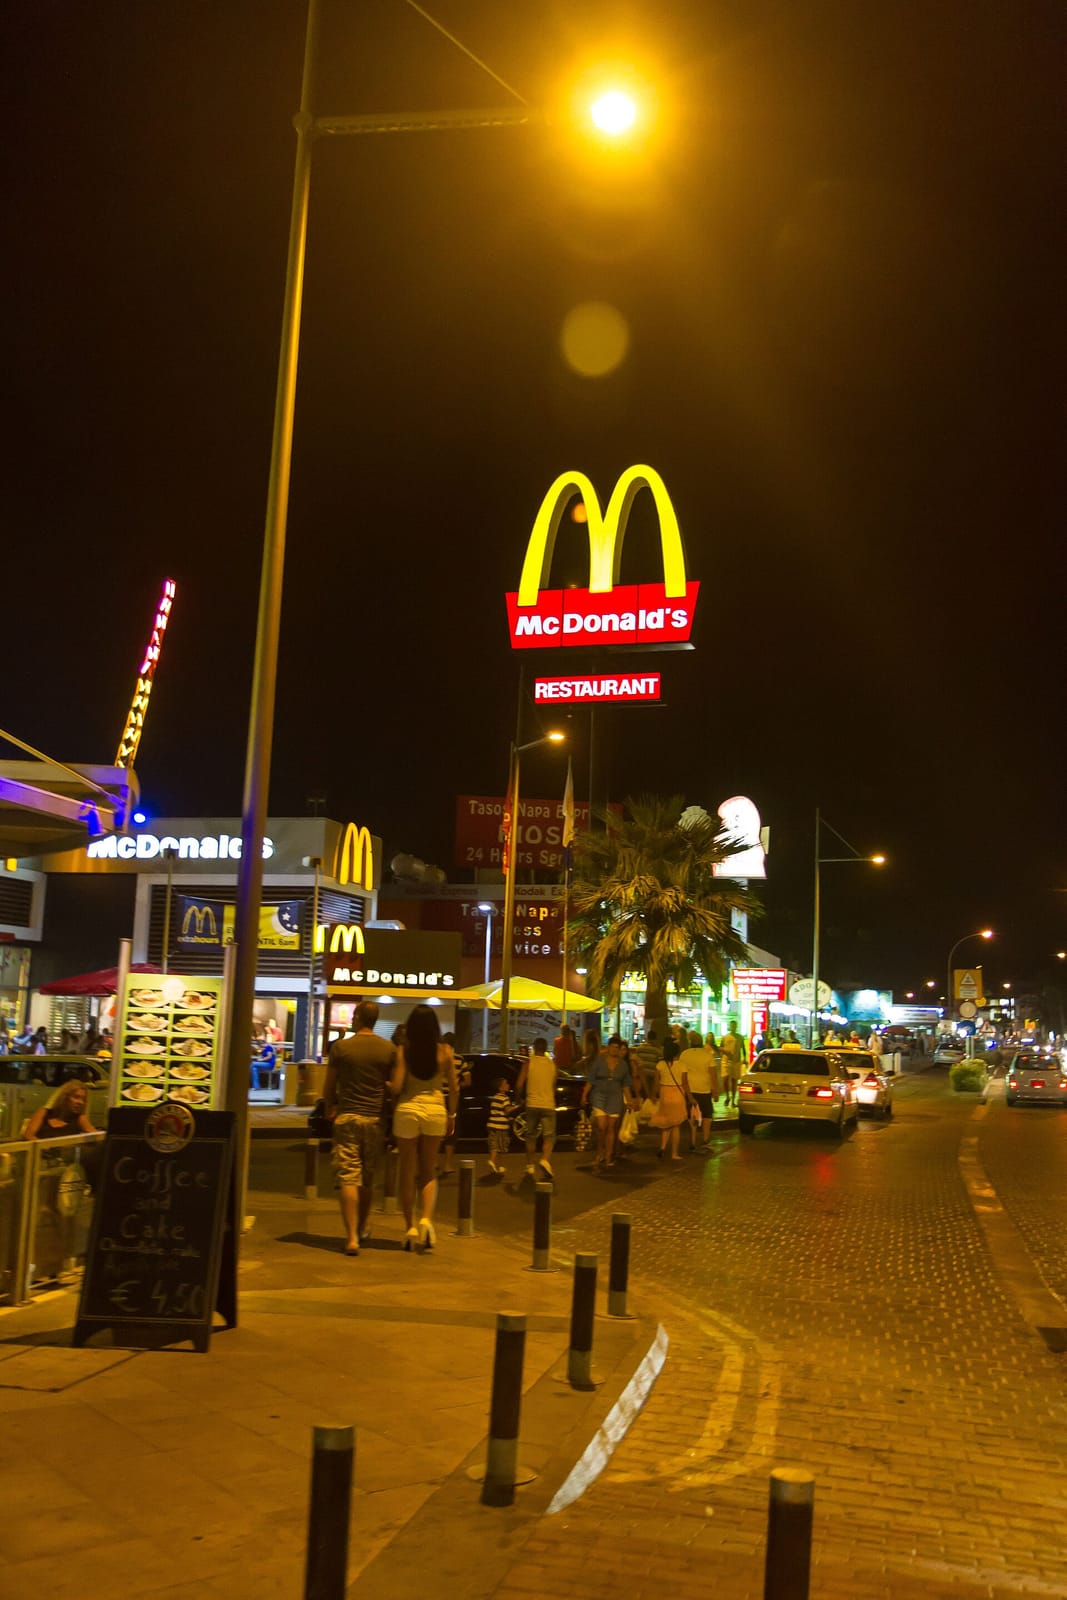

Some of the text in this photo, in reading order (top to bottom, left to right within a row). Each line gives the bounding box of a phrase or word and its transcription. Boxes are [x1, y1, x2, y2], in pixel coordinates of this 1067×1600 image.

[514, 608, 688, 636] McDonald's
[534, 678, 659, 699] RESTAURANT
[466, 847, 483, 862] 24
[490, 848, 533, 864] Hrs
[515, 904, 559, 921] Napa
[333, 967, 454, 986] McDonald's
[113, 1156, 210, 1193] Coffee
[119, 1213, 185, 1240] Cake
